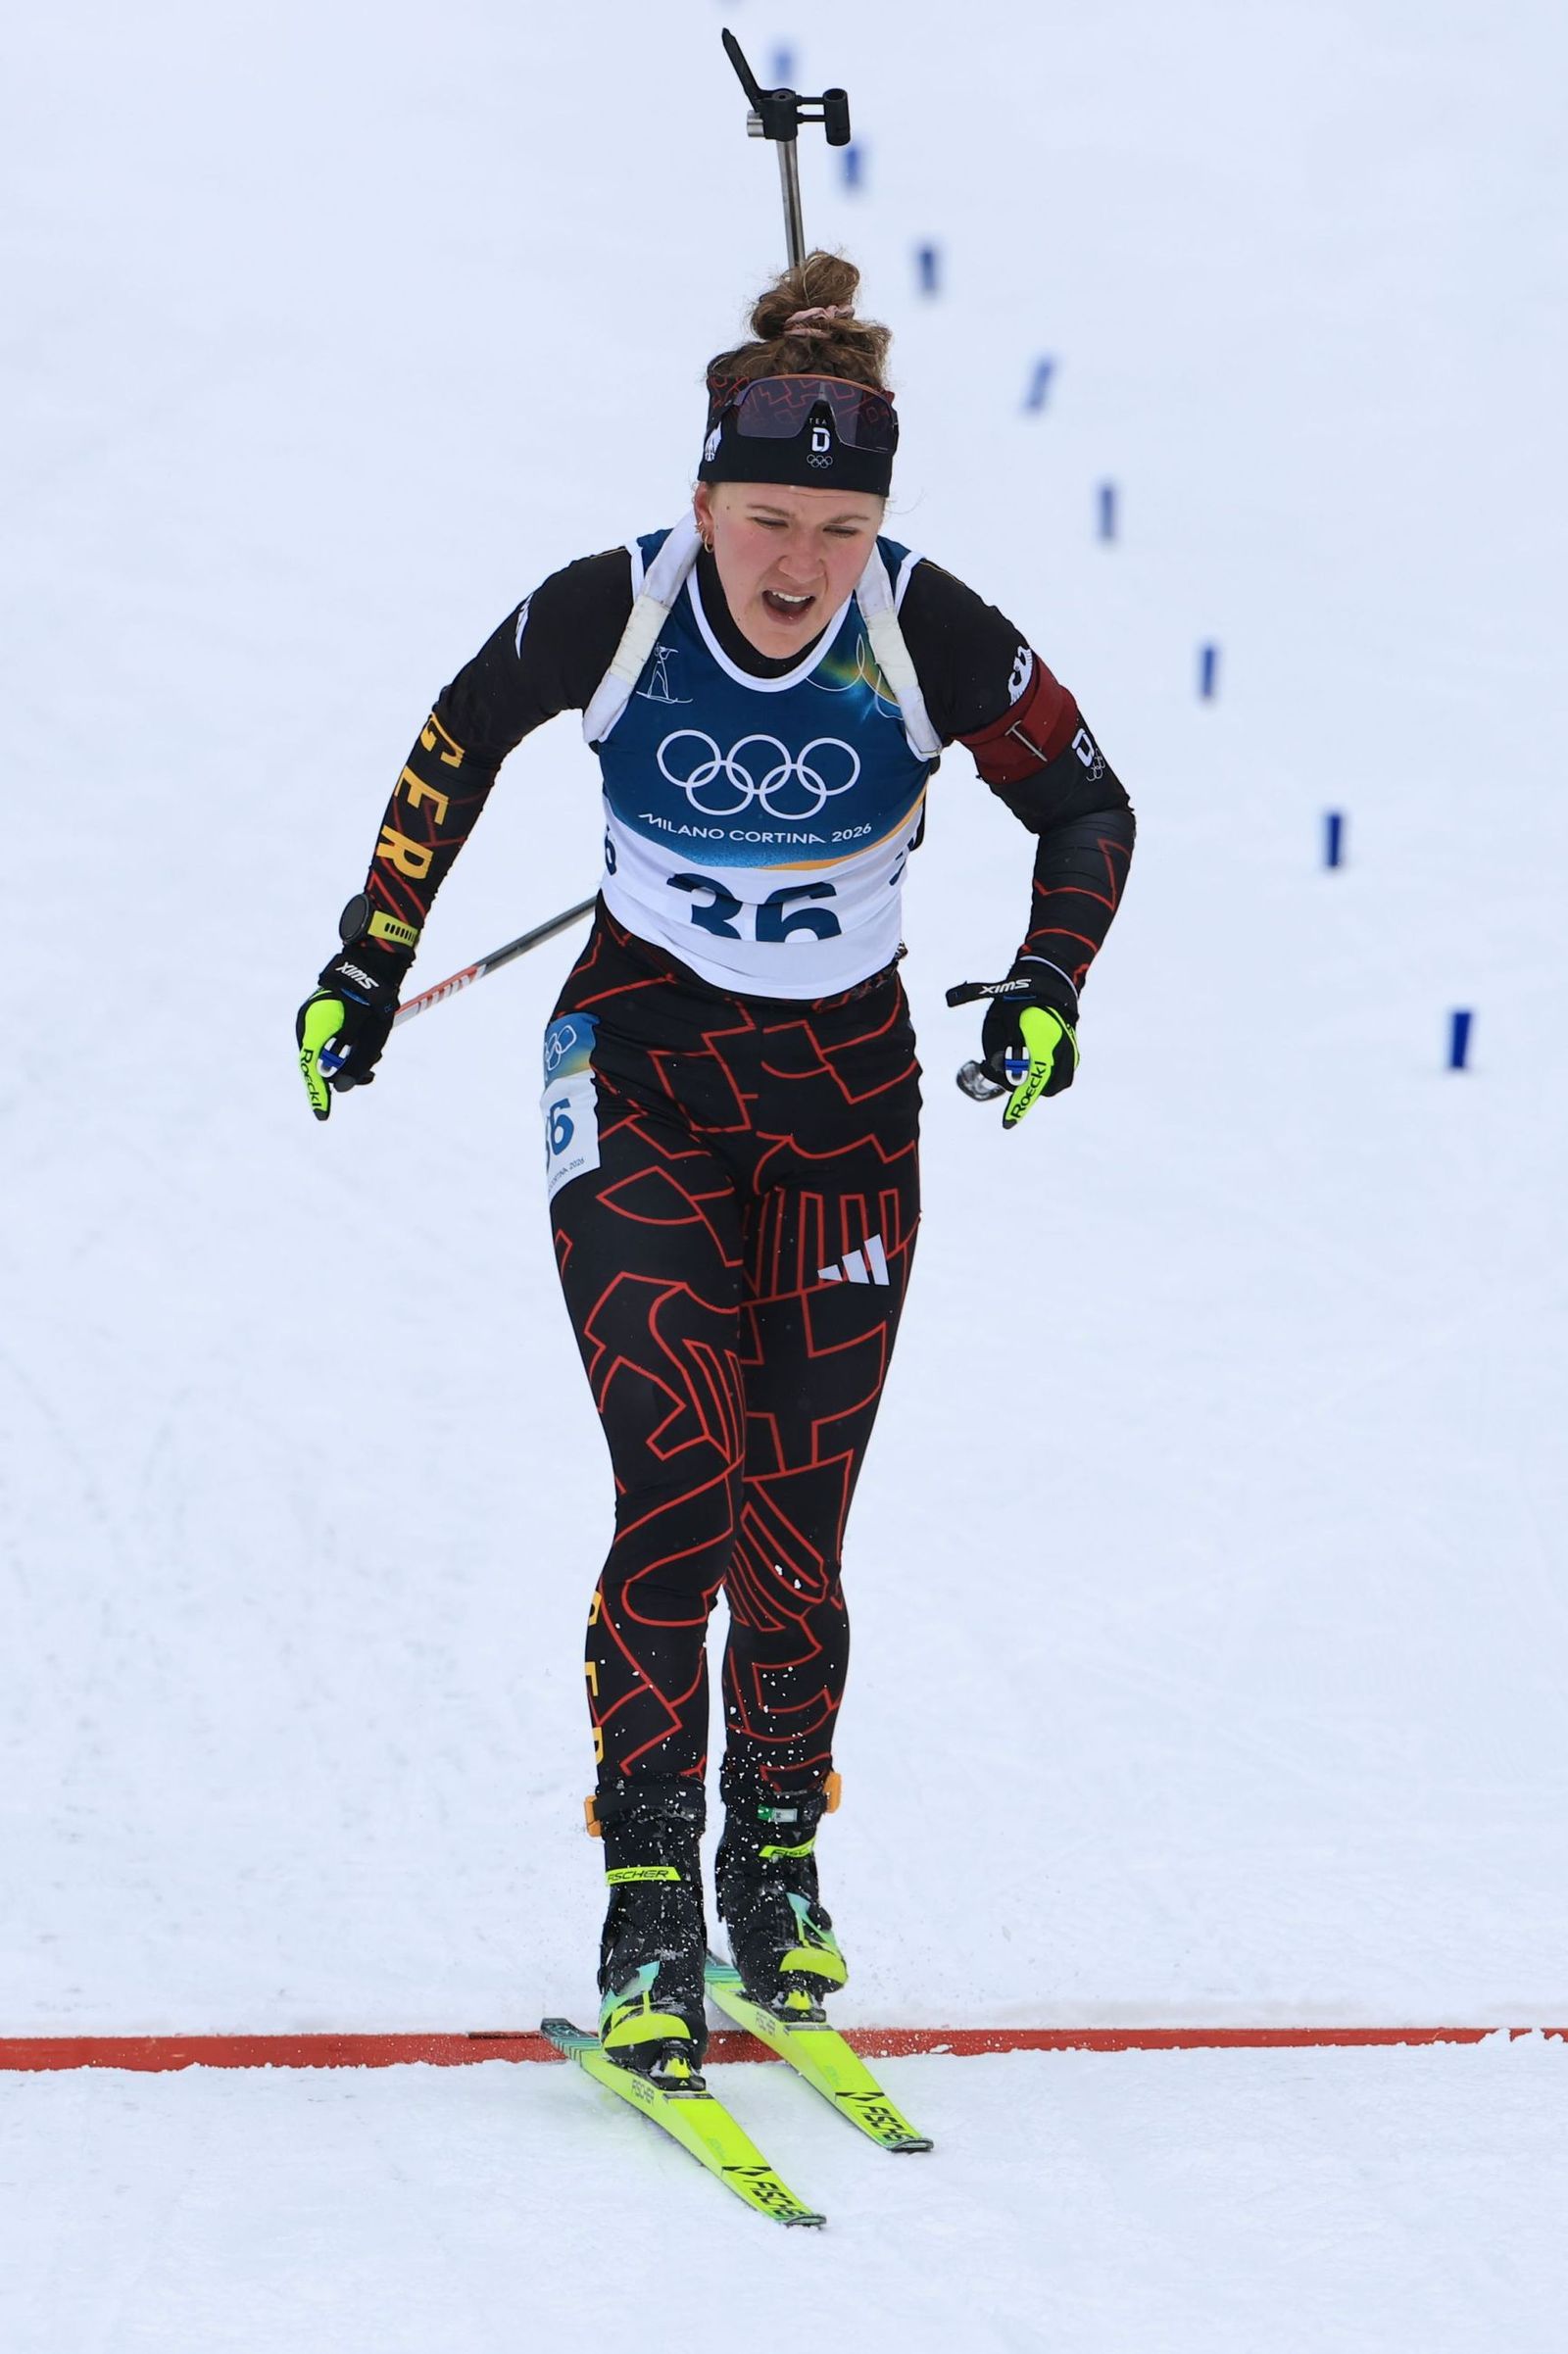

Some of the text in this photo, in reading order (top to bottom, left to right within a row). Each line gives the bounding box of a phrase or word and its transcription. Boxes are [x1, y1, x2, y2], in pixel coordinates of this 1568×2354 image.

[638, 812, 872, 845] MILANO CORTINA 2026
[666, 872, 843, 944] 36
